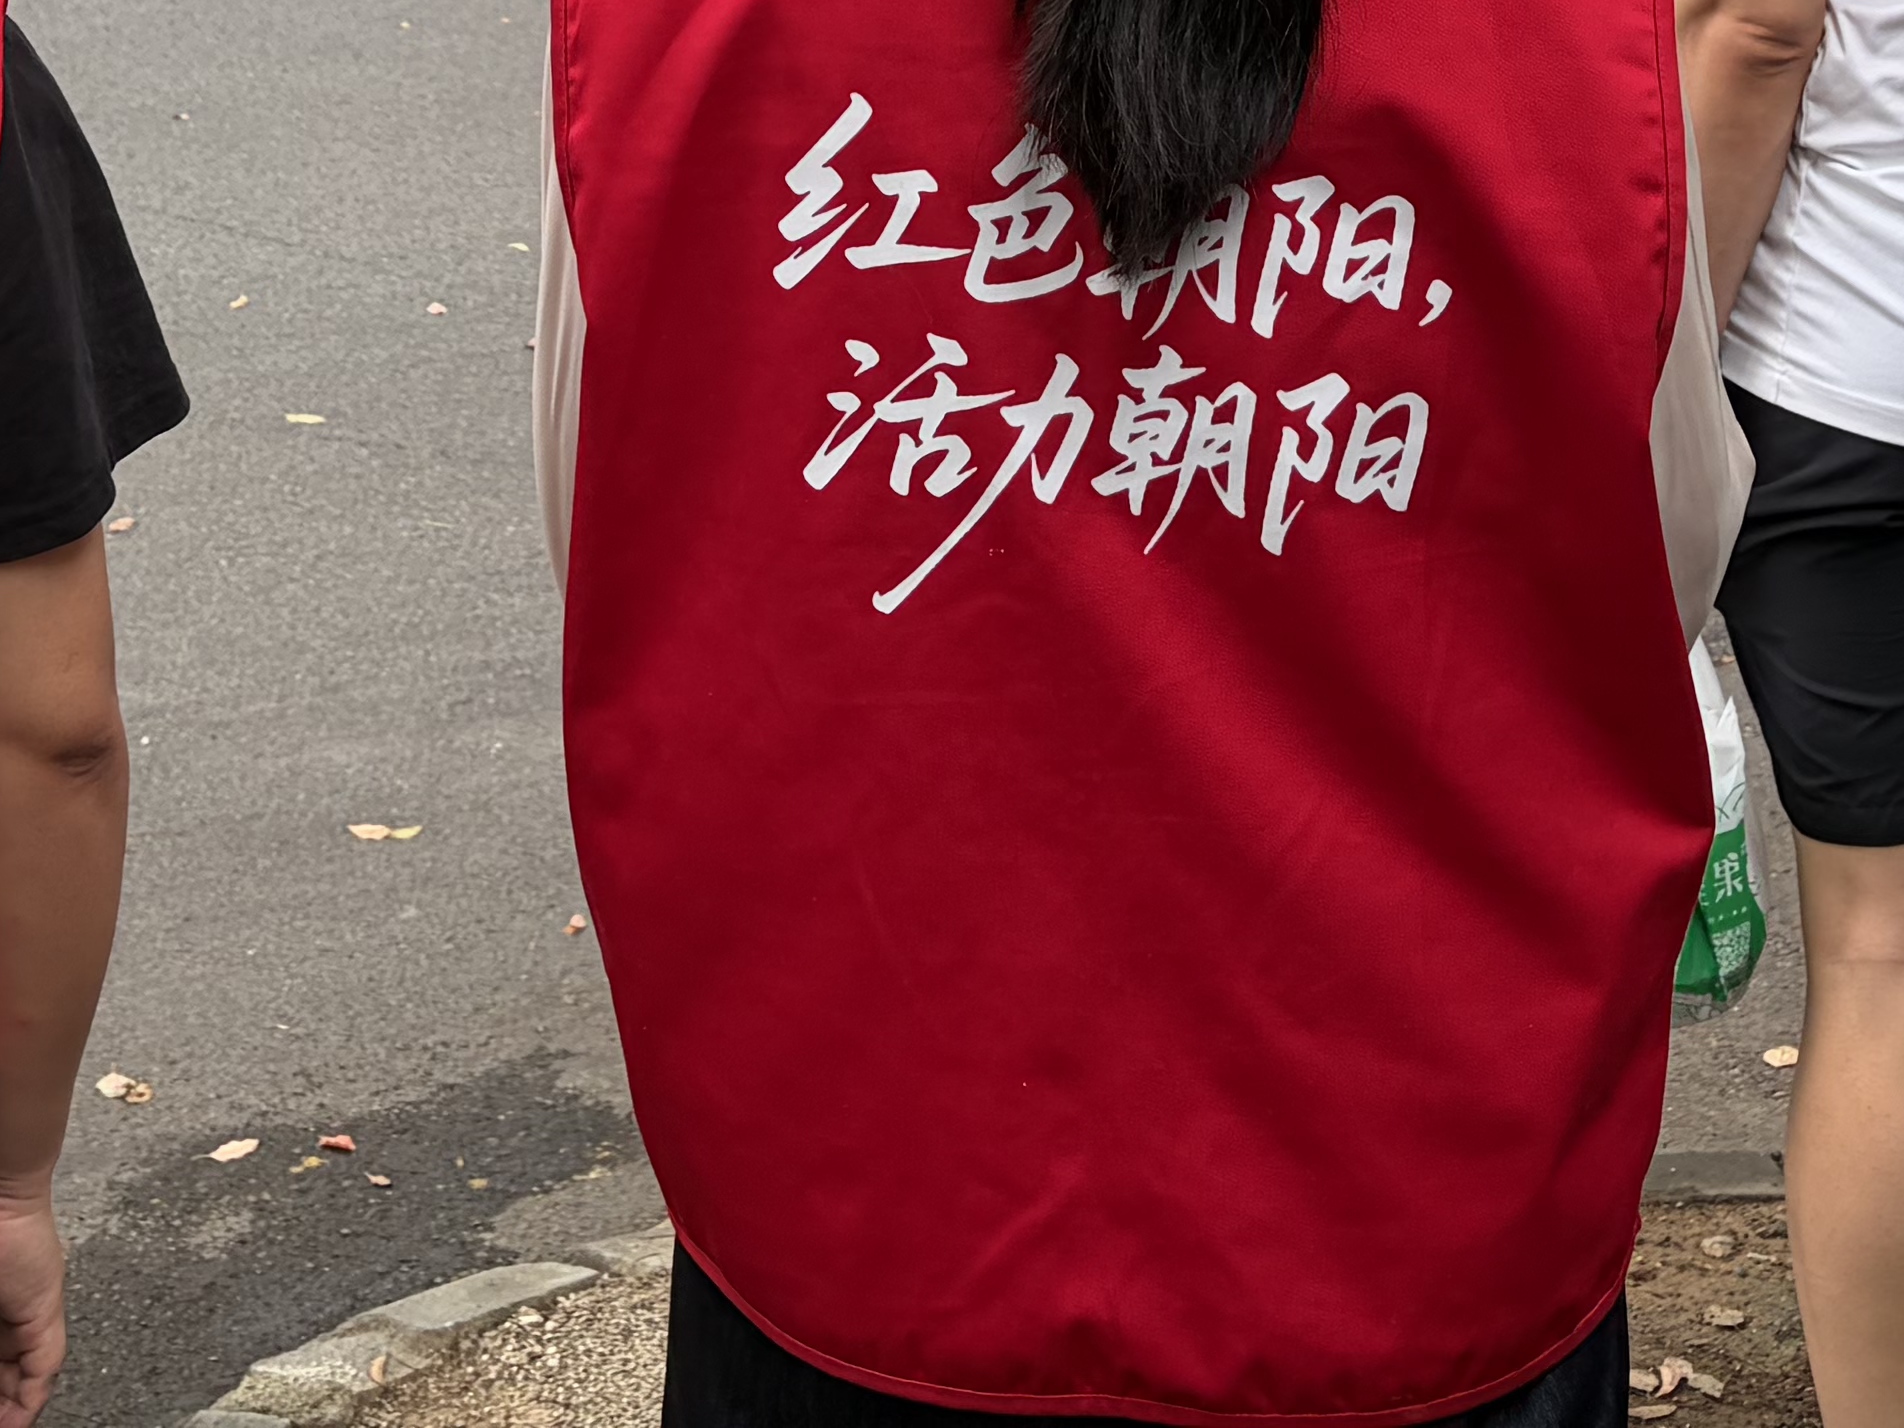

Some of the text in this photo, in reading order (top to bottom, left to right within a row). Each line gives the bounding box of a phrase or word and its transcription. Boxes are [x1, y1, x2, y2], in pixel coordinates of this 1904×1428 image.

[803, 333, 1429, 613] 活力朝阳
[1713, 852, 1744, 903] 果
